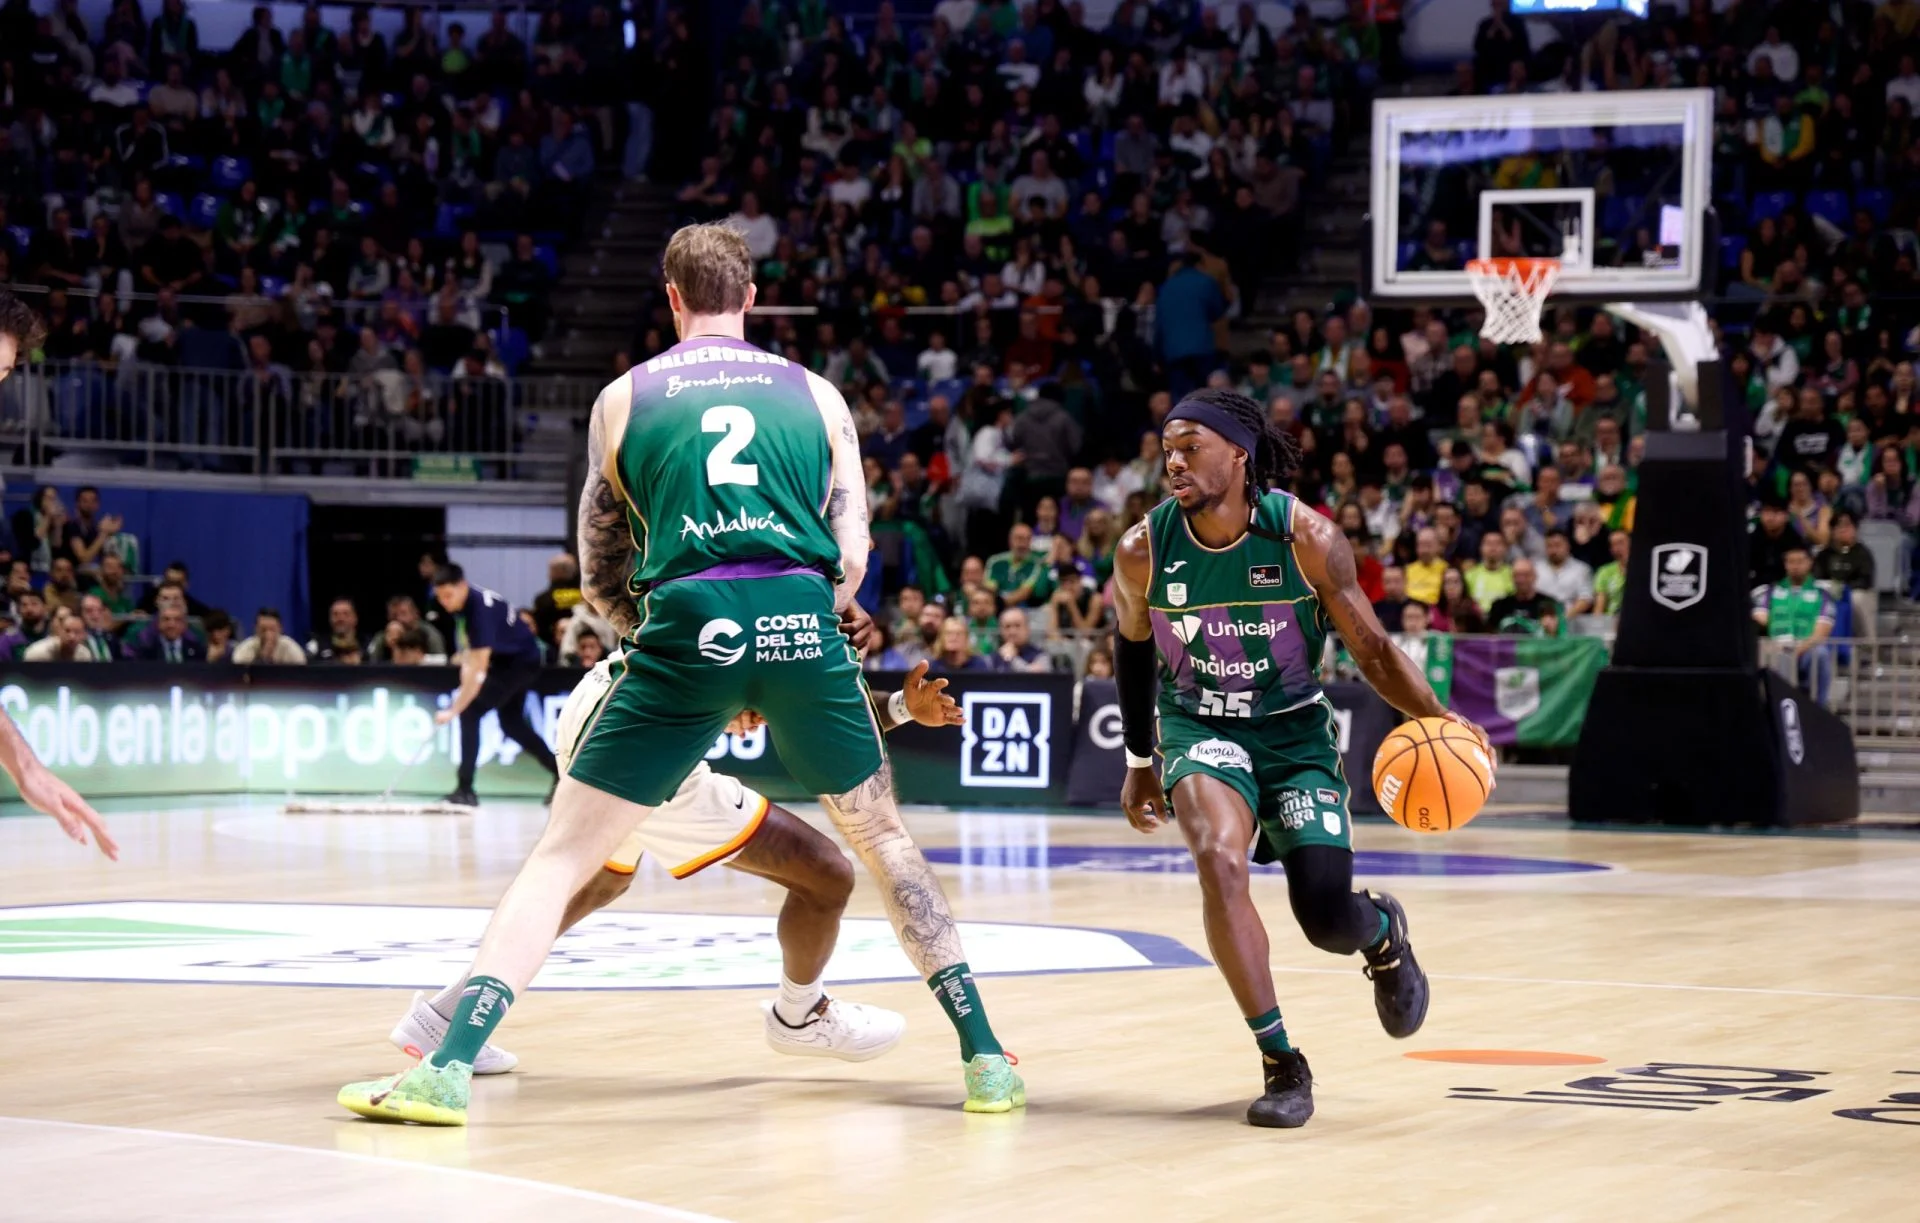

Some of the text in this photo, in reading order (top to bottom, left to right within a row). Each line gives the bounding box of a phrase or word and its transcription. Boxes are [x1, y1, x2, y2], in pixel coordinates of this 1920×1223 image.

[701, 405, 759, 487] 2
[679, 505, 797, 541] Andalucía
[755, 613, 820, 633] COSTA
[756, 630, 822, 648] DEL SOL
[1207, 618, 1288, 640] Unicaja
[755, 646, 824, 663] MÁLAGA
[1198, 687, 1253, 718] 55
[0, 683, 101, 768] Solo
[106, 703, 163, 767] en
[169, 685, 208, 765] la
[214, 703, 328, 780] app
[467, 986, 501, 1028] UNICAJA
[942, 976, 973, 1018] UNICAJA
